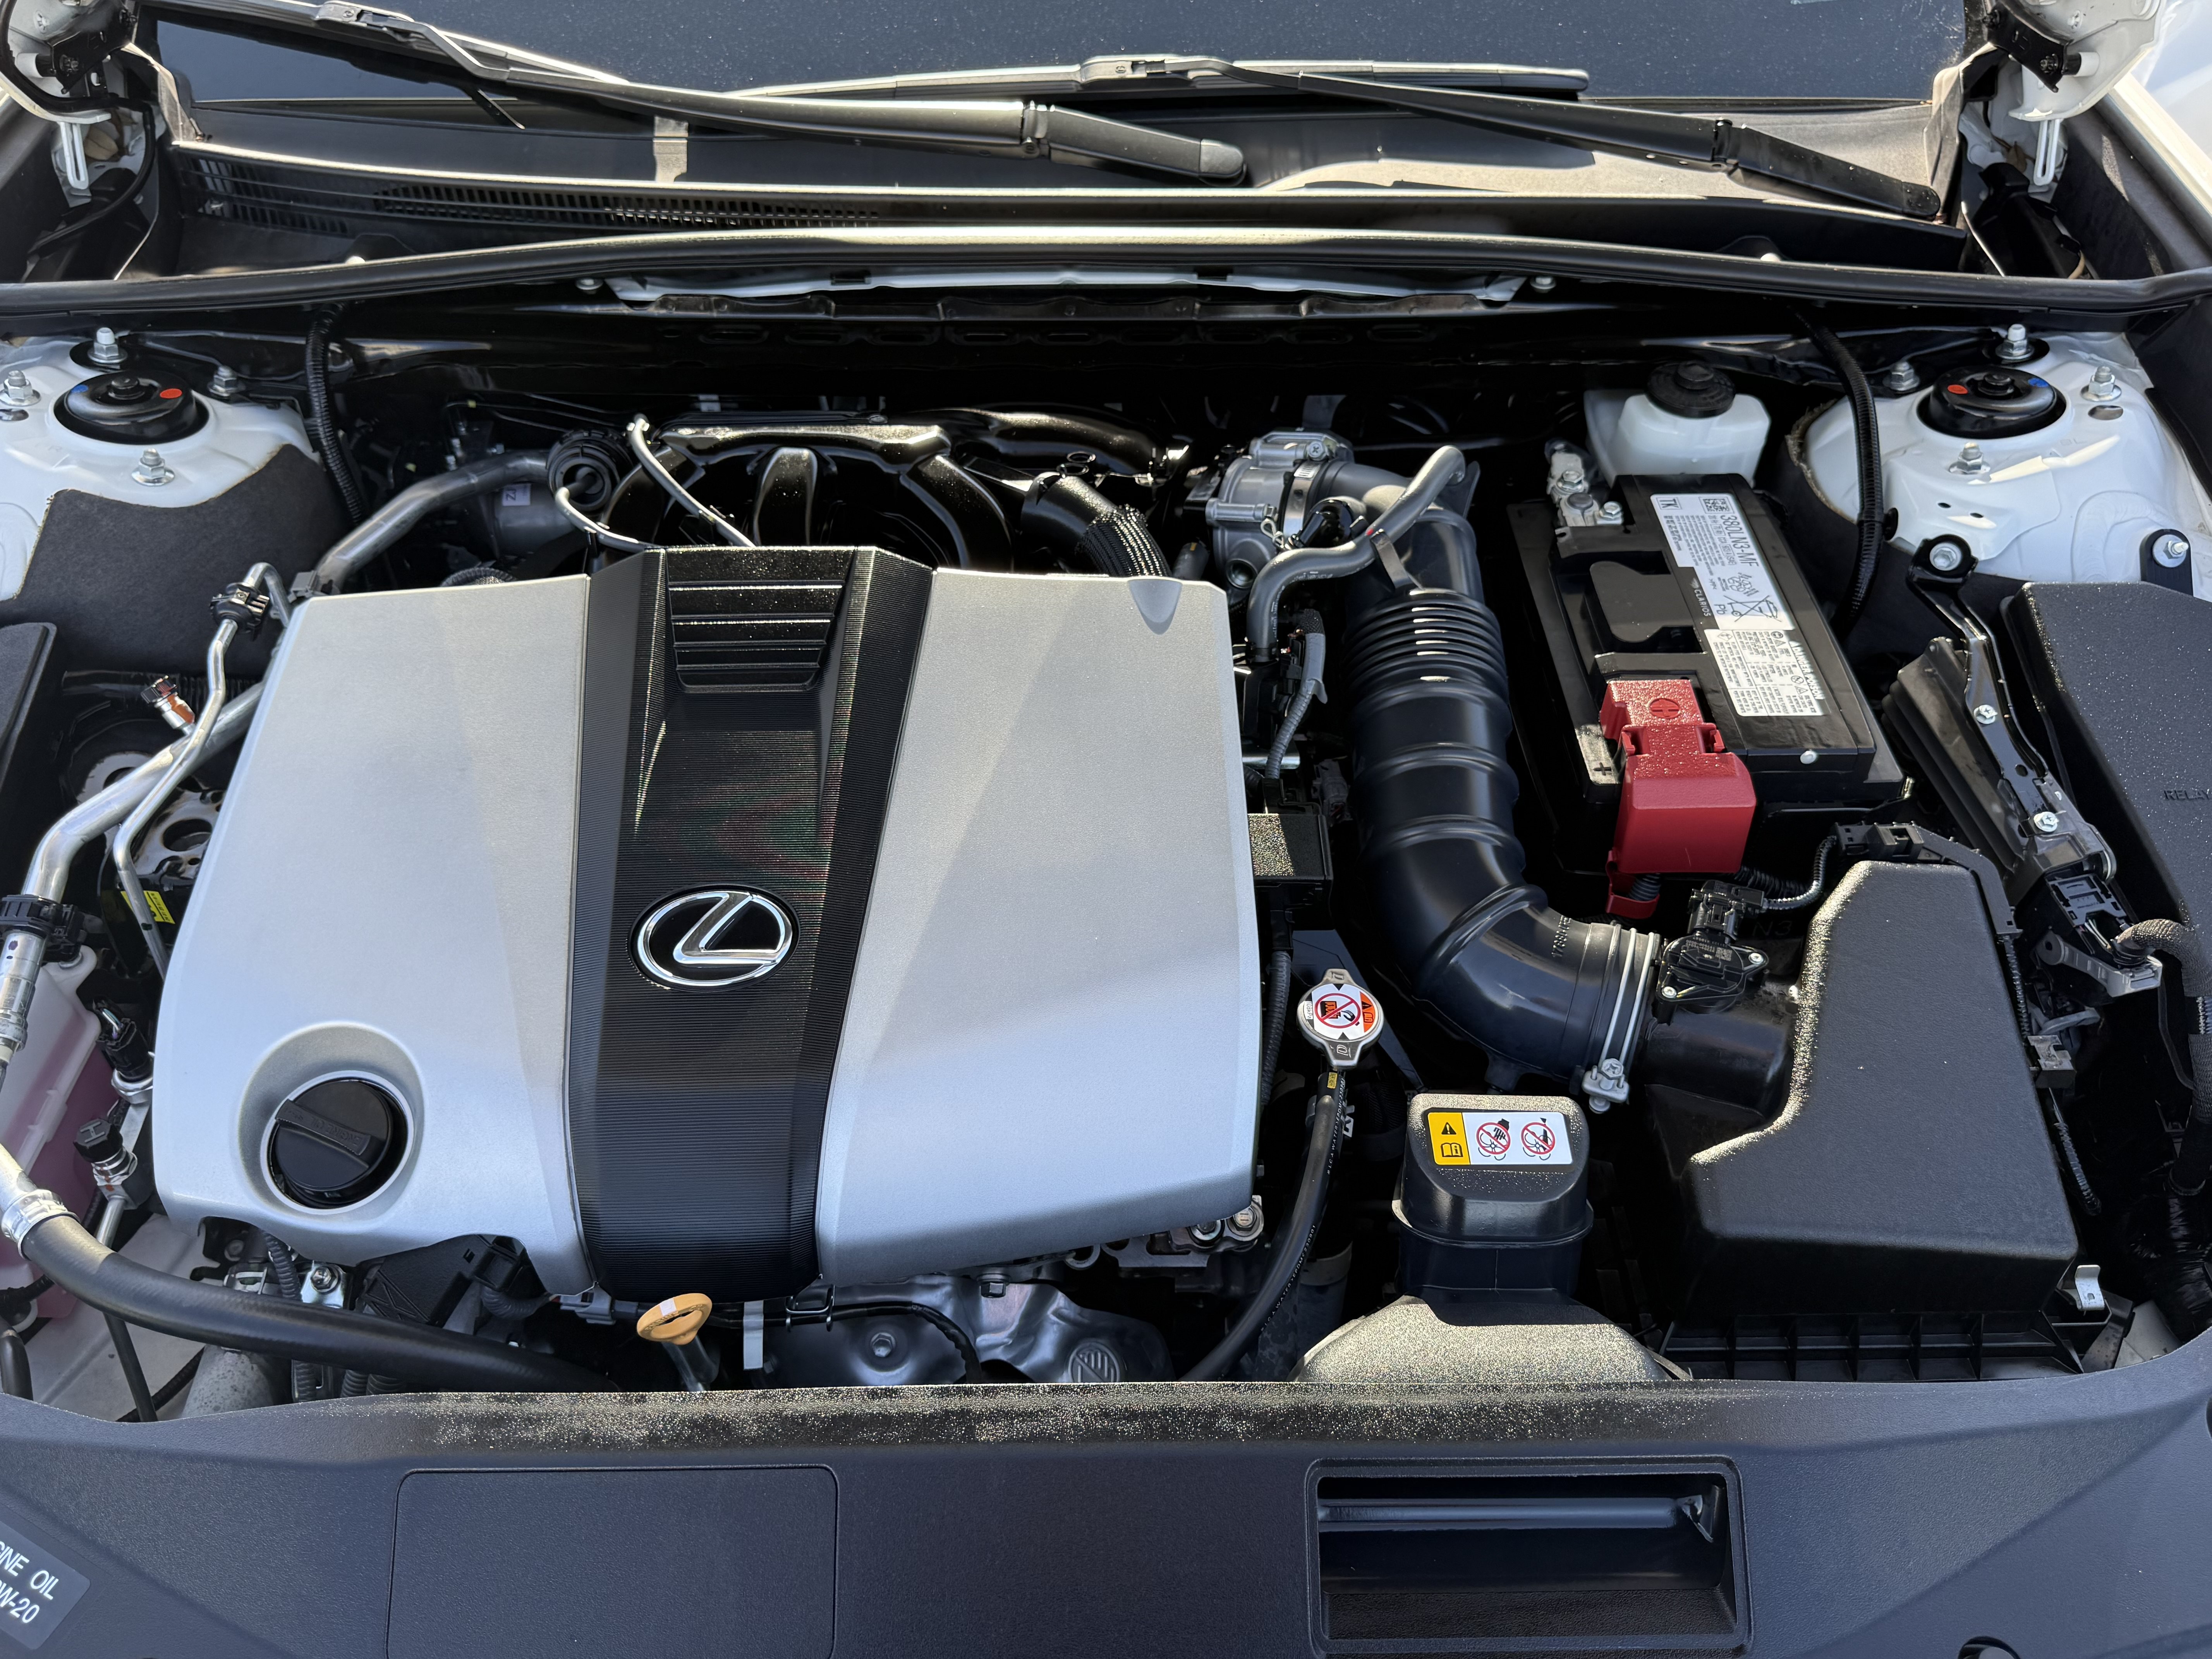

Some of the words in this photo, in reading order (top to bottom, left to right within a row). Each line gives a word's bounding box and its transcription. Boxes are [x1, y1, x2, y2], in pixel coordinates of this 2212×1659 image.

[1659, 498, 1680, 509] TK
[1720, 515, 1759, 567] 380LN3-MF
[1694, 589, 1711, 618] CLARIOS
[1714, 604, 1726, 615] Pb
[30, 1570, 59, 1600] OIL
[0, 1580, 40, 1623] W-20
